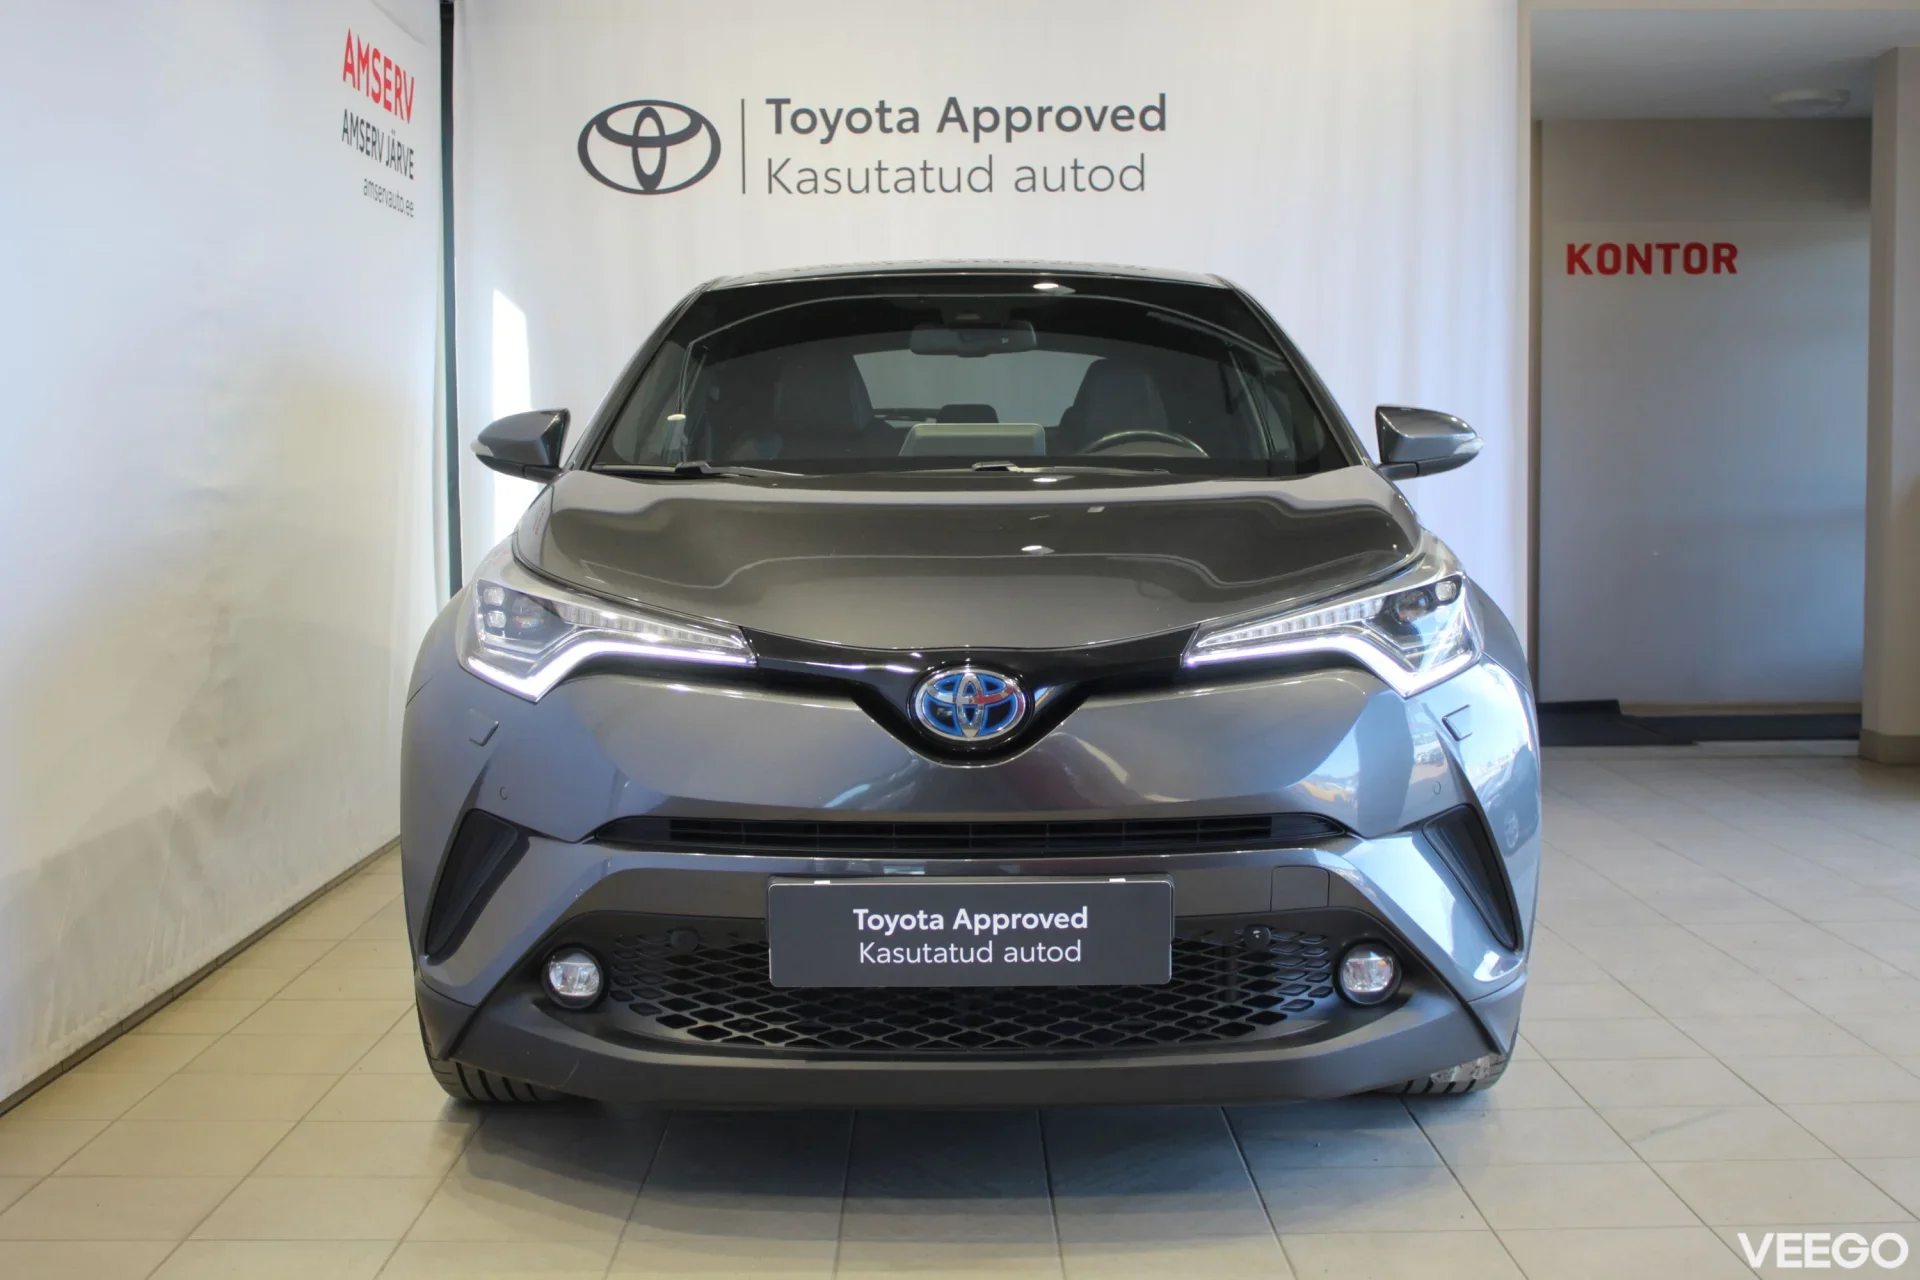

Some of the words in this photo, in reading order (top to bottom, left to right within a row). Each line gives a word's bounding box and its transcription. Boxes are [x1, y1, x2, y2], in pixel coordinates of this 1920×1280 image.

[343, 27, 415, 125] AMSERV
[766, 98, 920, 145] Toyota
[936, 92, 1168, 144] Approved
[342, 108, 384, 163] AMSERV
[385, 128, 414, 180] JÄRVE
[766, 154, 994, 195] Kasutatud
[1014, 152, 1146, 193] autod
[363, 177, 415, 218] amservauto.ee
[1566, 242, 1739, 275] KONTOR
[853, 908, 945, 936] Toyota
[952, 906, 1089, 936] Approved
[859, 940, 994, 964] Kasutatud
[1003, 939, 1082, 963] autod
